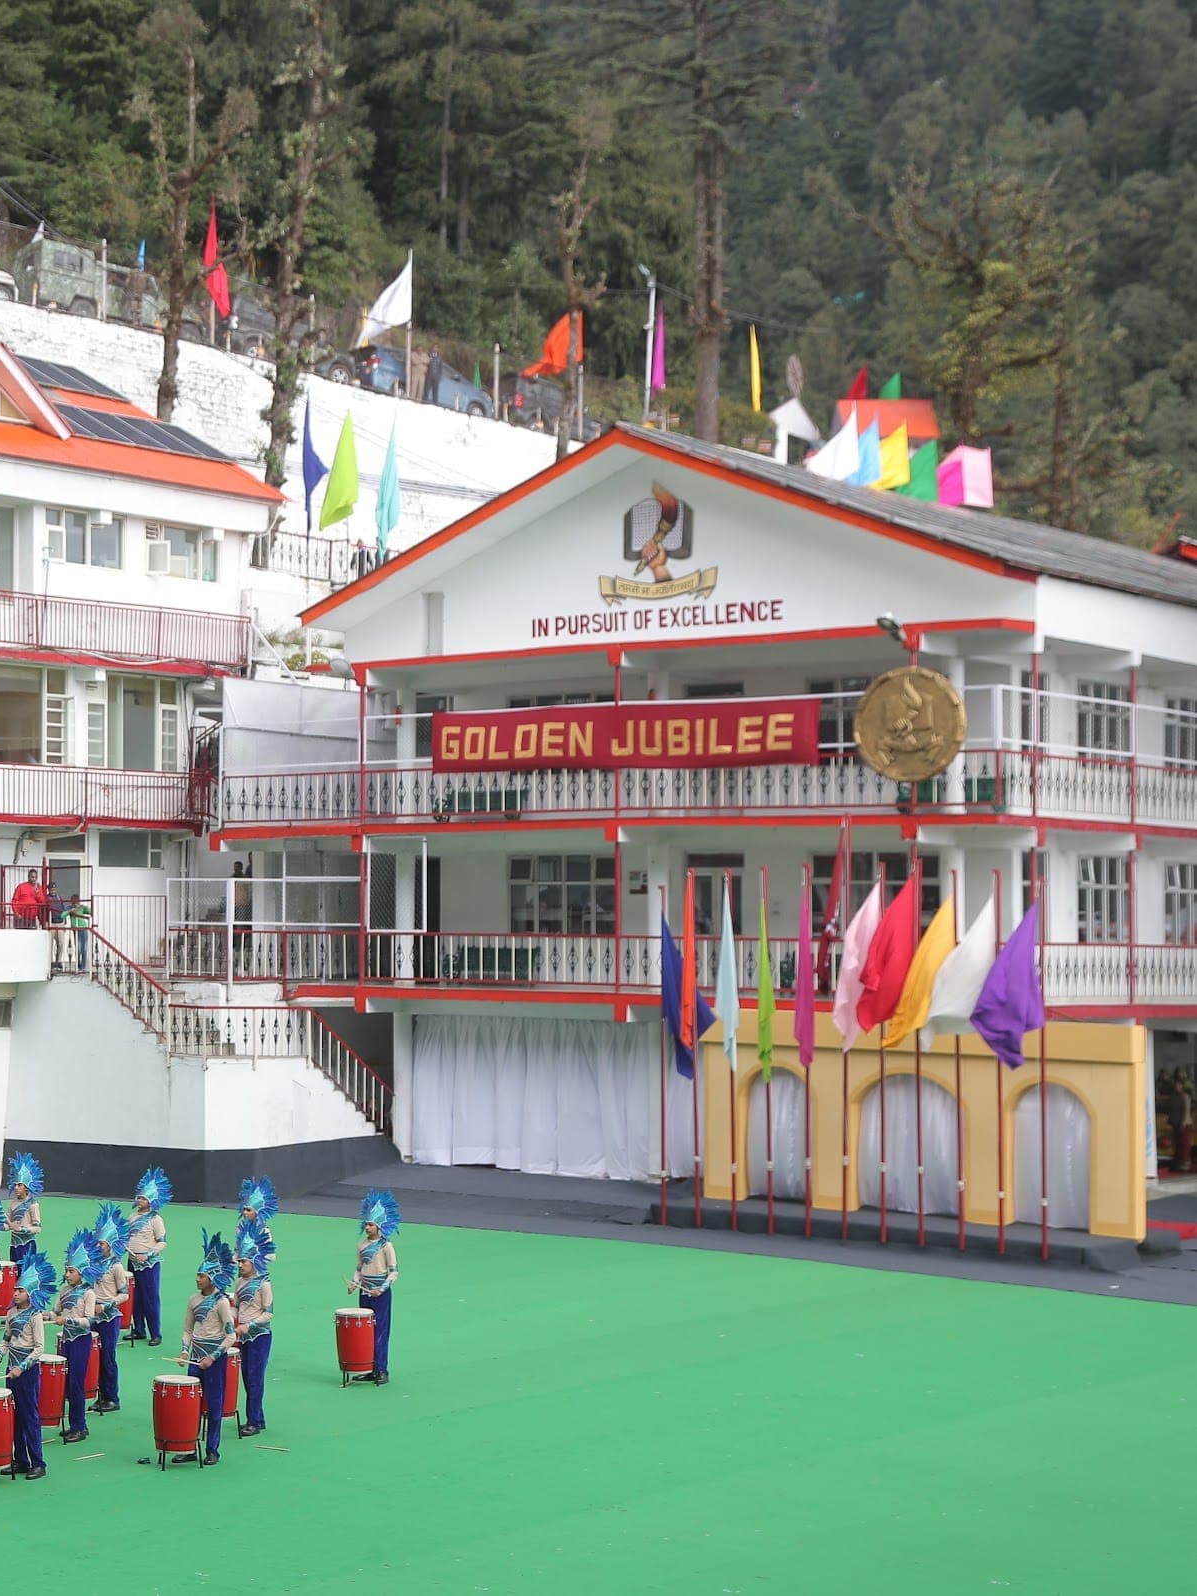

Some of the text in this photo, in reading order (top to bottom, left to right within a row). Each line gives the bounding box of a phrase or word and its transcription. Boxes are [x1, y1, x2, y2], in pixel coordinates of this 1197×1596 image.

[532, 599, 783, 638] IN PURSUIT OF EXCELLENCE
[441, 713, 795, 760] GOLDEN JUBILEE
